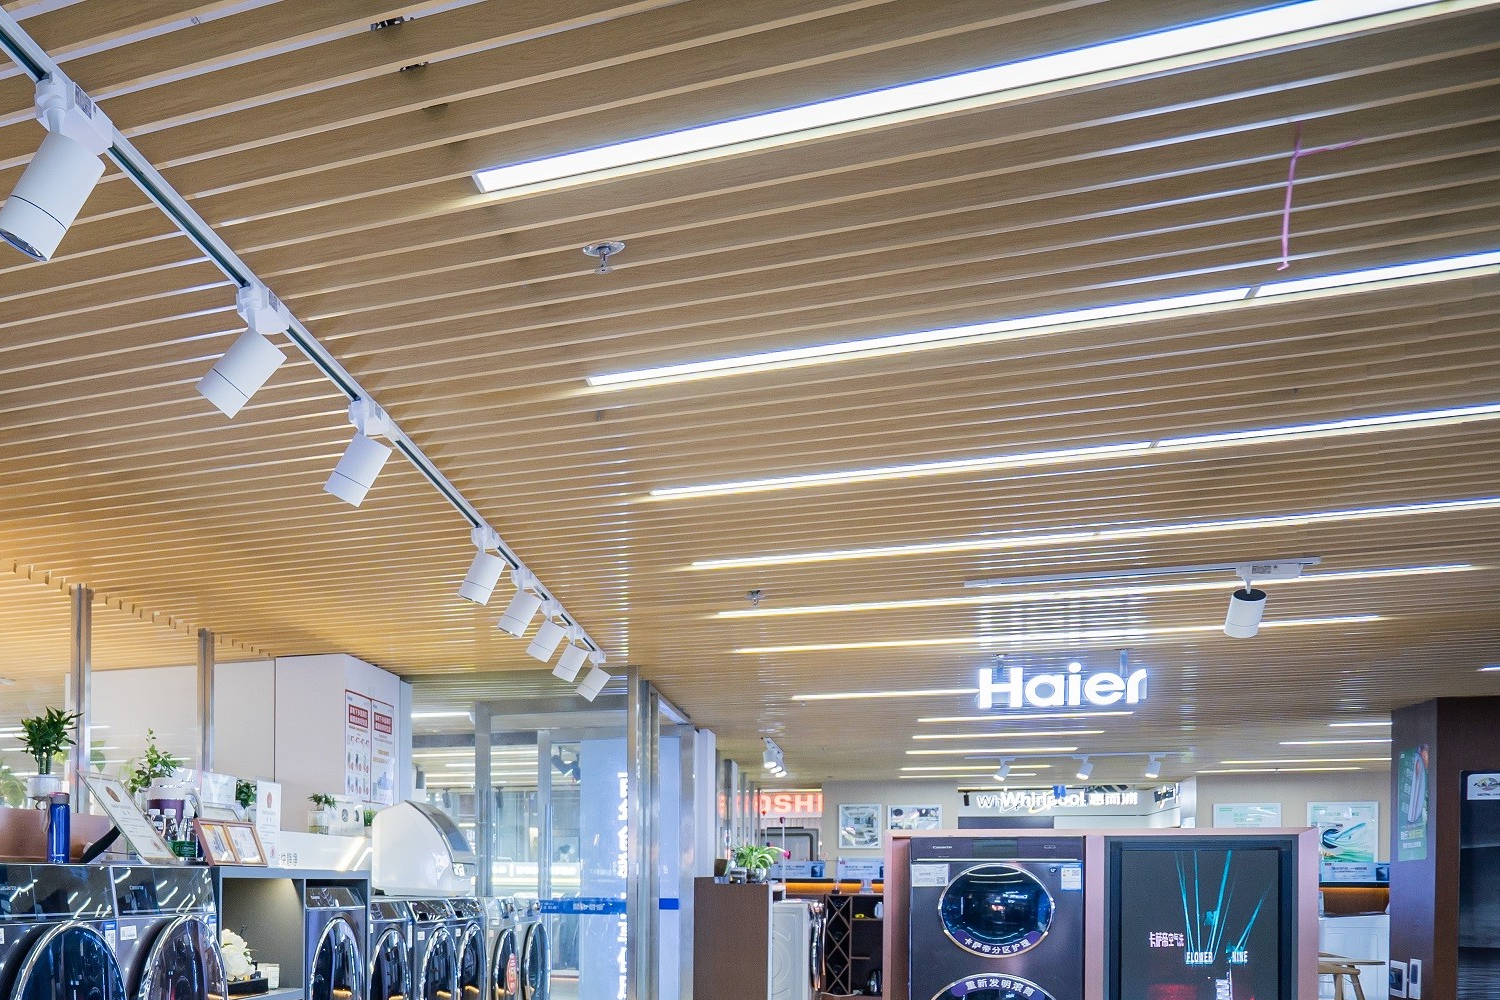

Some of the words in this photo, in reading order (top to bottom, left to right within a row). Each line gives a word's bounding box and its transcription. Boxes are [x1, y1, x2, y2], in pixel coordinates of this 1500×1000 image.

[979, 662, 1148, 709] Haier
[964, 938, 1032, 954] 卡萨帝分区护理
[965, 978, 1036, 997] 重新发明滚筒
